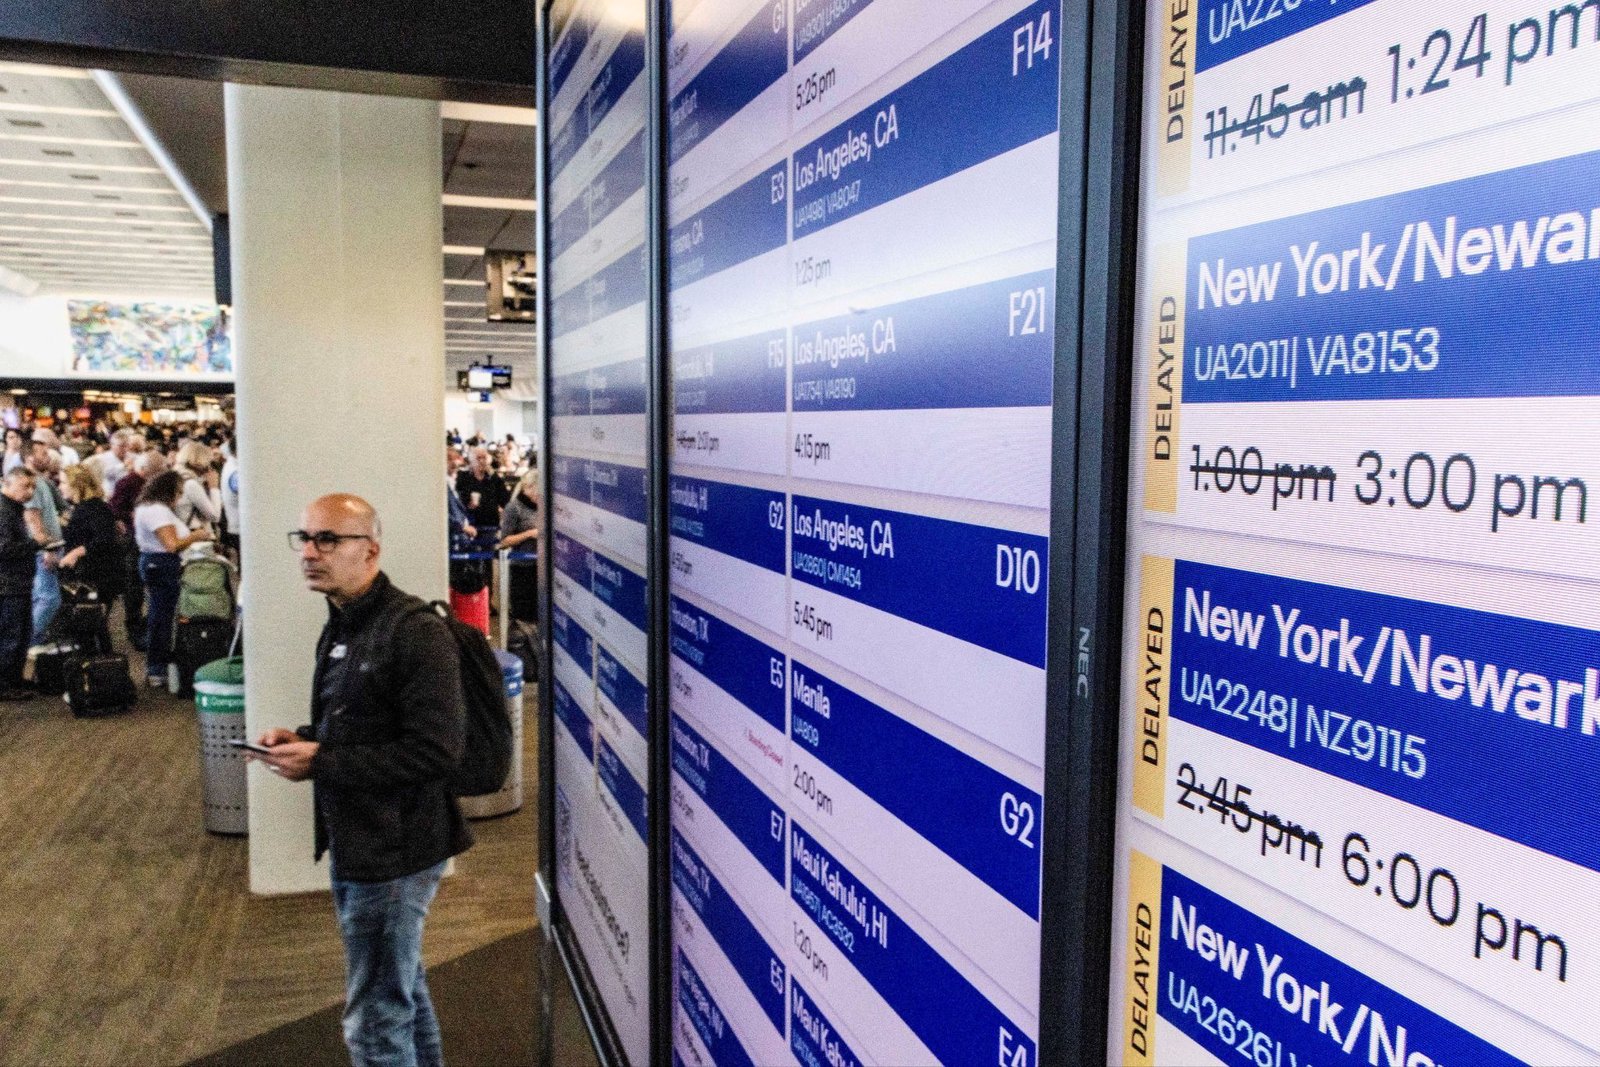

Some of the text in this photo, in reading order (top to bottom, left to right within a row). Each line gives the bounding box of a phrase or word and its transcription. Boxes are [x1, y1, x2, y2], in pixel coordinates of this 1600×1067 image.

[1012, 10, 1053, 77] F14
[1388, 0, 1600, 103] 1:24 pm
[796, 67, 836, 111] 5:25 pm
[1204, 75, 1367, 160] 11:45 am
[795, 104, 899, 193] Los Angeles, CA
[771, 171, 784, 205] E3
[795, 257, 832, 288] 1:25 pm
[1197, 258, 1281, 310] New
[1009, 286, 1046, 338] F21
[794, 316, 897, 369] Los Angeles, CA
[1307, 326, 1441, 377] VA8153
[1153, 296, 1177, 461] DELAYED
[795, 433, 831, 466] 4:15 pm
[1189, 444, 1337, 511] 1:00 pm
[769, 500, 784, 530] G2
[1355, 449, 1589, 533] 3:00 pm
[793, 504, 895, 559] Los Angeles, CA
[996, 543, 1041, 595] D10
[794, 600, 833, 641] 5:45 pm
[1183, 587, 1266, 650] New
[770, 656, 784, 690] E5
[1077, 627, 1090, 699] NEC
[1142, 605, 1165, 767] DELAYED
[793, 669, 831, 719] Manila
[1305, 705, 1428, 780] NZ9115
[793, 763, 833, 817] 2:00 pm
[1176, 762, 1324, 869] 2:45 pm
[770, 809, 784, 842] E7
[1000, 791, 1035, 849] G2
[793, 831, 888, 949] Maui Kahului, HI
[1342, 832, 1569, 983] 6:00 pm
[793, 921, 829, 981] 1:20 pm
[1130, 902, 1153, 1059] DELAYED
[1170, 894, 1446, 1067] New York/N
[793, 987, 820, 1045] Maui
